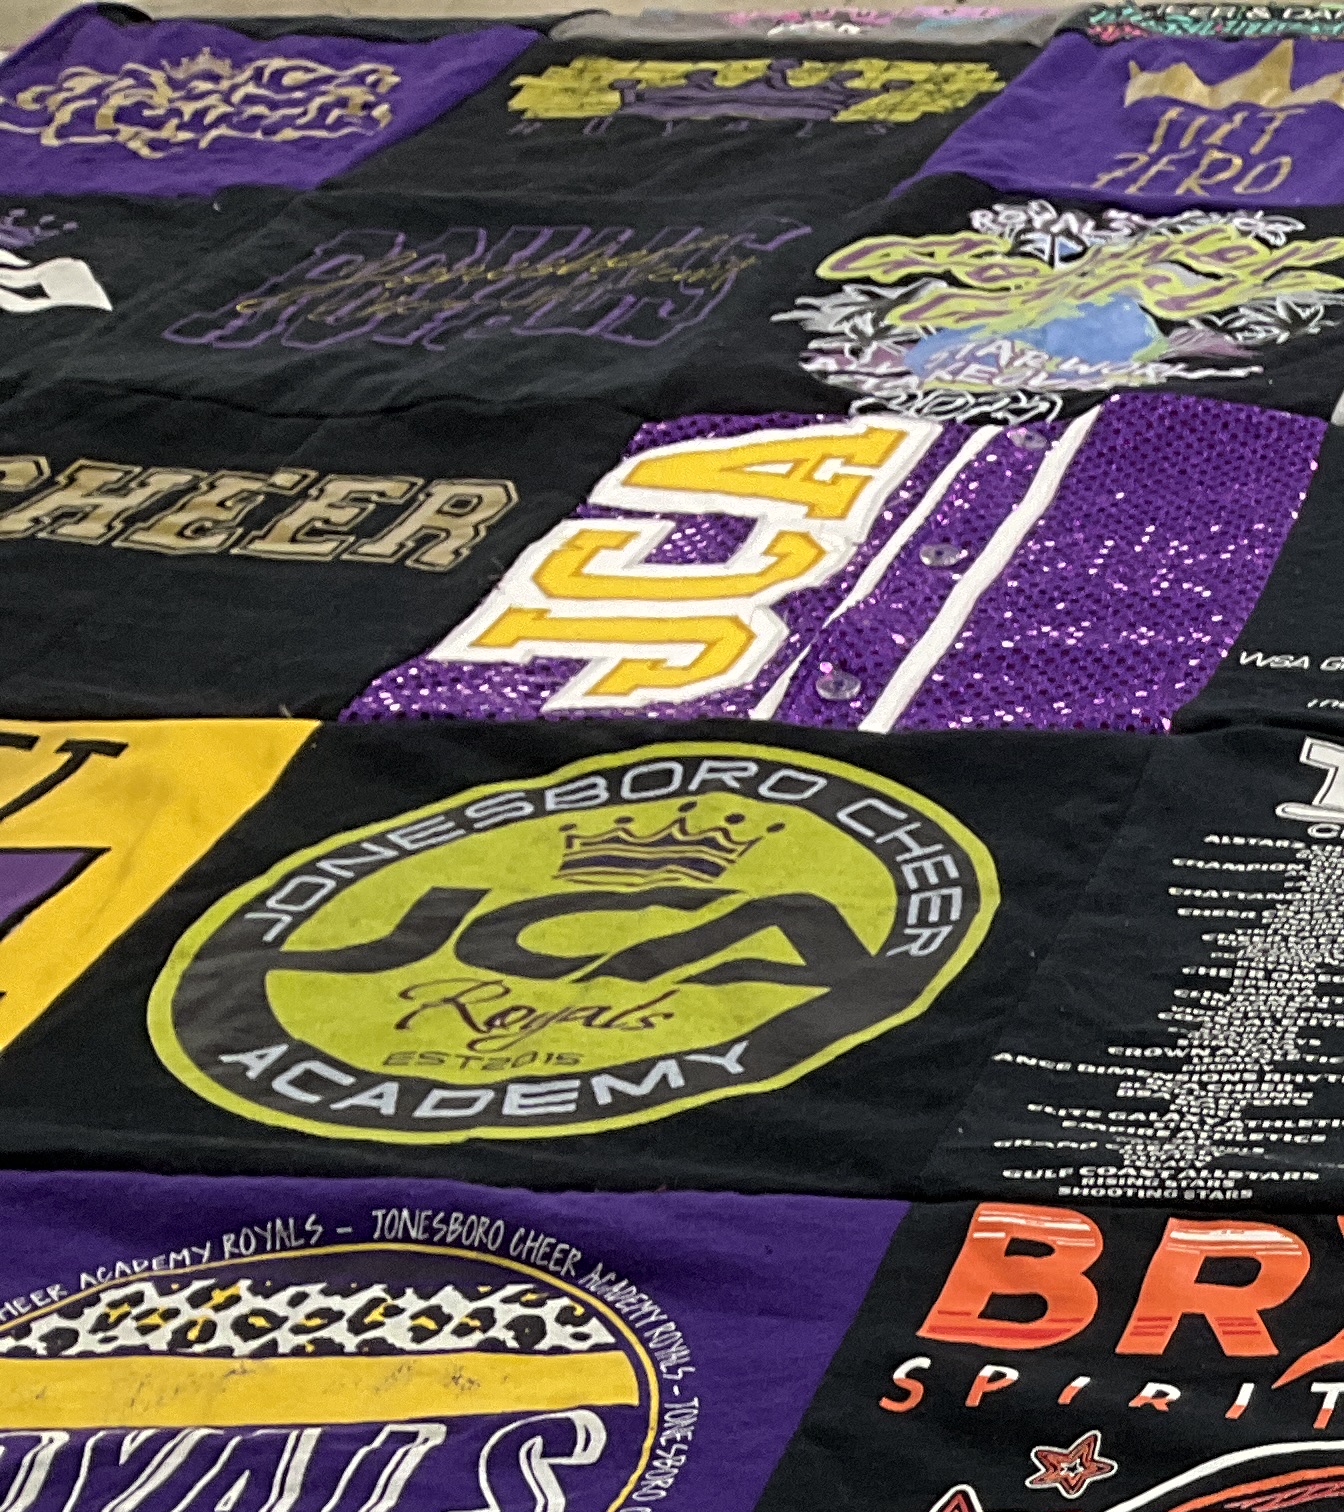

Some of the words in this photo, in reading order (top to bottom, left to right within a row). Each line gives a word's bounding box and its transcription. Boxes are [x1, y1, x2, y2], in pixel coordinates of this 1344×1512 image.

[1240, 651, 1310, 670] WSA
[242, 757, 828, 945] JONESBORO
[836, 796, 963, 959] CHEER
[278, 885, 888, 992] JCA
[394, 978, 684, 1052] Royals
[217, 1038, 749, 1120] ACADEMY
[79, 1239, 212, 1290] ACADEMY
[222, 1213, 324, 1258] ROYALS
[372, 1207, 506, 1250] JONESBORO
[508, 1226, 582, 1277] CHEER
[581, 1263, 668, 1330] ACADEMY
[643, 1320, 696, 1382] ROYALS
